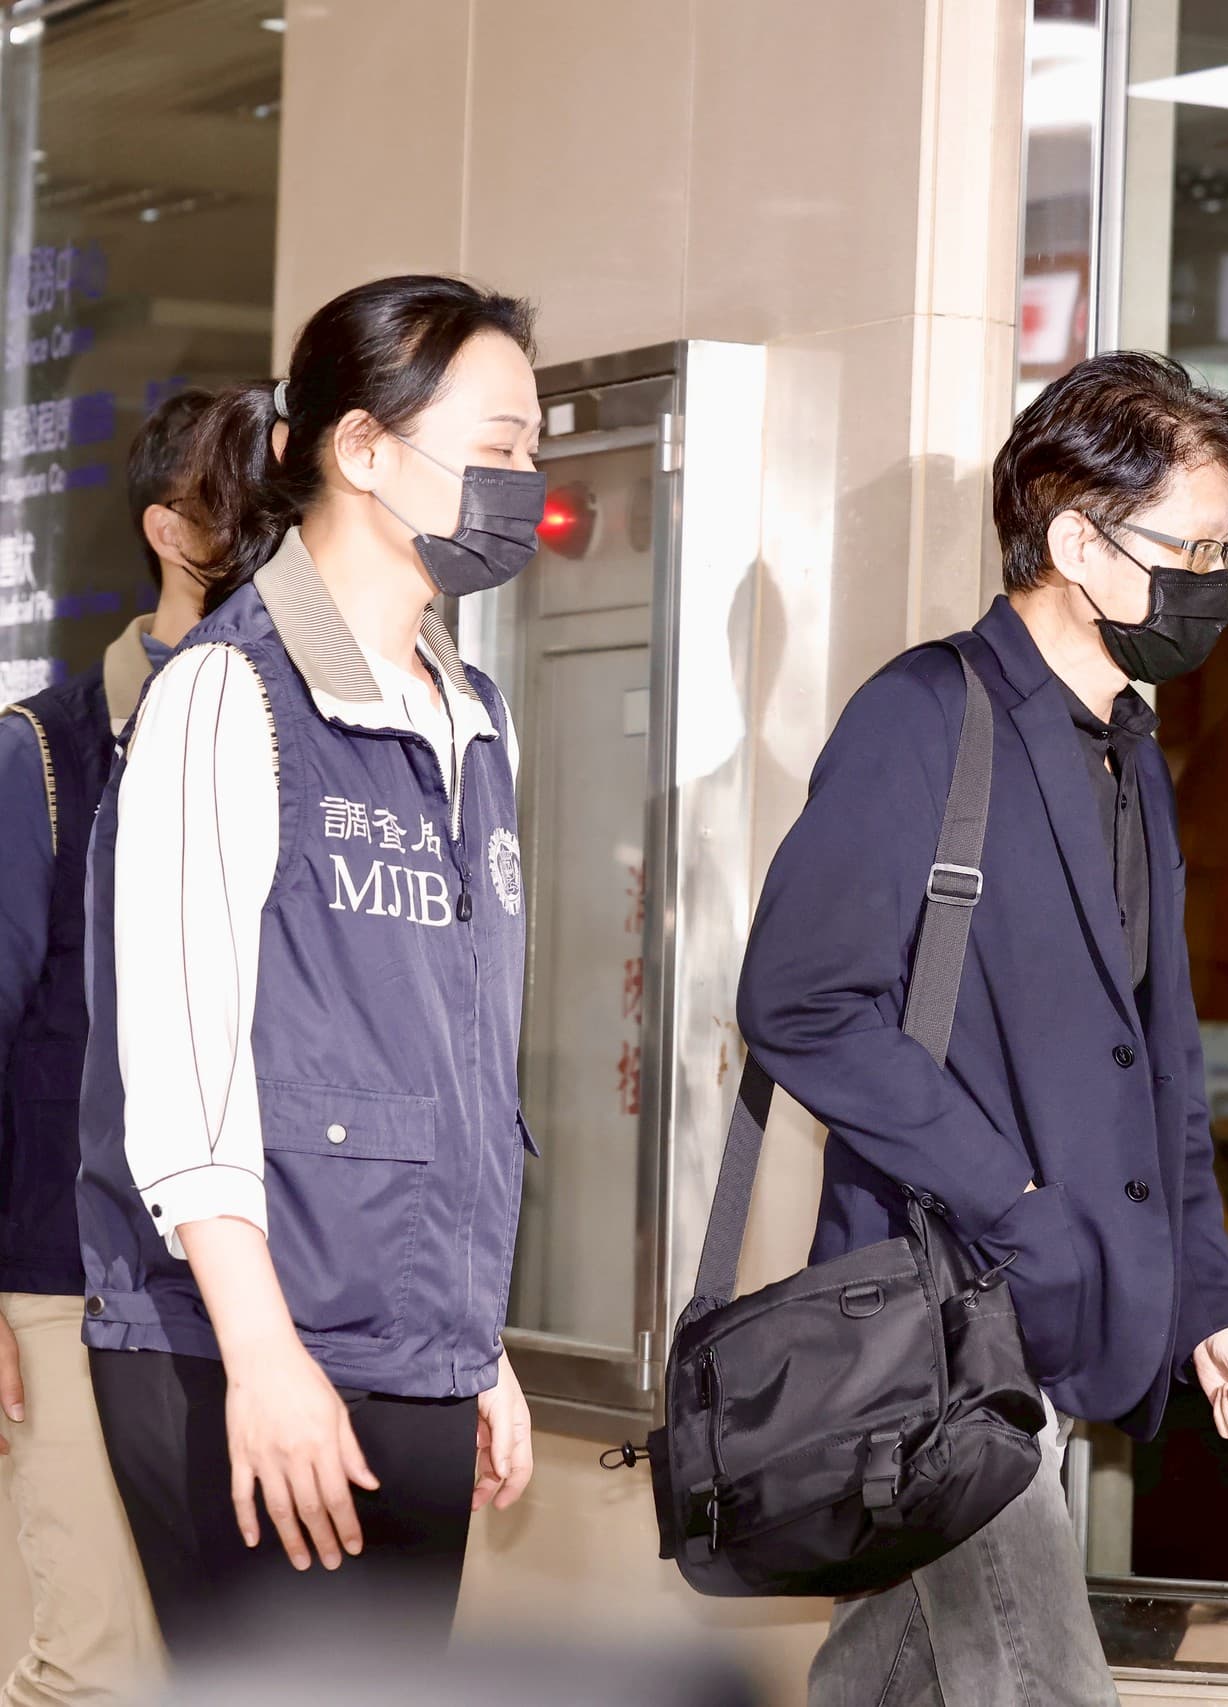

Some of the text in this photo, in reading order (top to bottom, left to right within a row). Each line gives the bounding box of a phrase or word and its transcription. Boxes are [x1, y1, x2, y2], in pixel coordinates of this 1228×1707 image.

[320, 796, 442, 862] 調查局
[329, 854, 452, 926] MJIB
